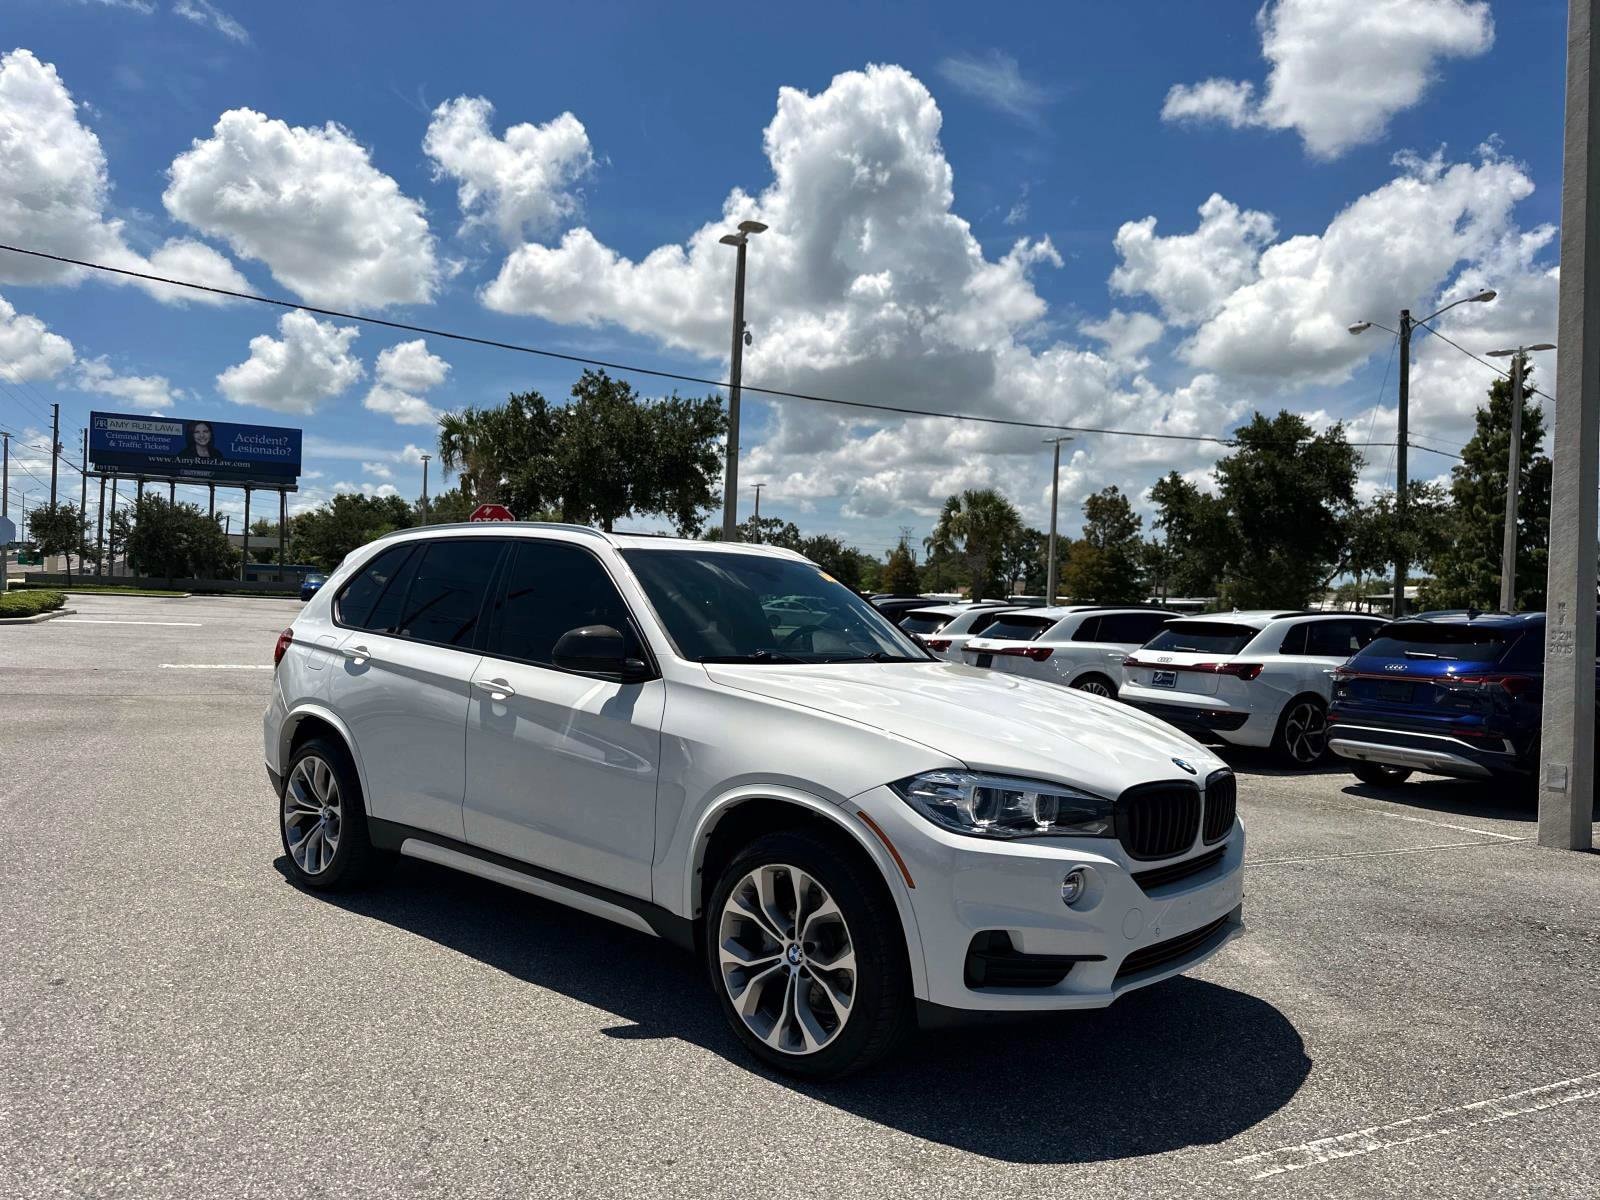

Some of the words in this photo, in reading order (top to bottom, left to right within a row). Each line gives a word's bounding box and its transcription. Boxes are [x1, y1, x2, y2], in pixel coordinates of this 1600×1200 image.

[109, 420, 129, 429] AMY
[131, 422, 152, 431] RUIZ
[155, 424, 174, 432] LAW
[105, 431, 140, 441] Criminal
[141, 434, 172, 443] Defense
[234, 432, 289, 446] Accident?
[118, 440, 142, 449] Traffic
[144, 442, 170, 451] Tickets
[231, 442, 292, 456] Lesionado?
[148, 455, 250, 468] www.AmyRuizLaw.com
